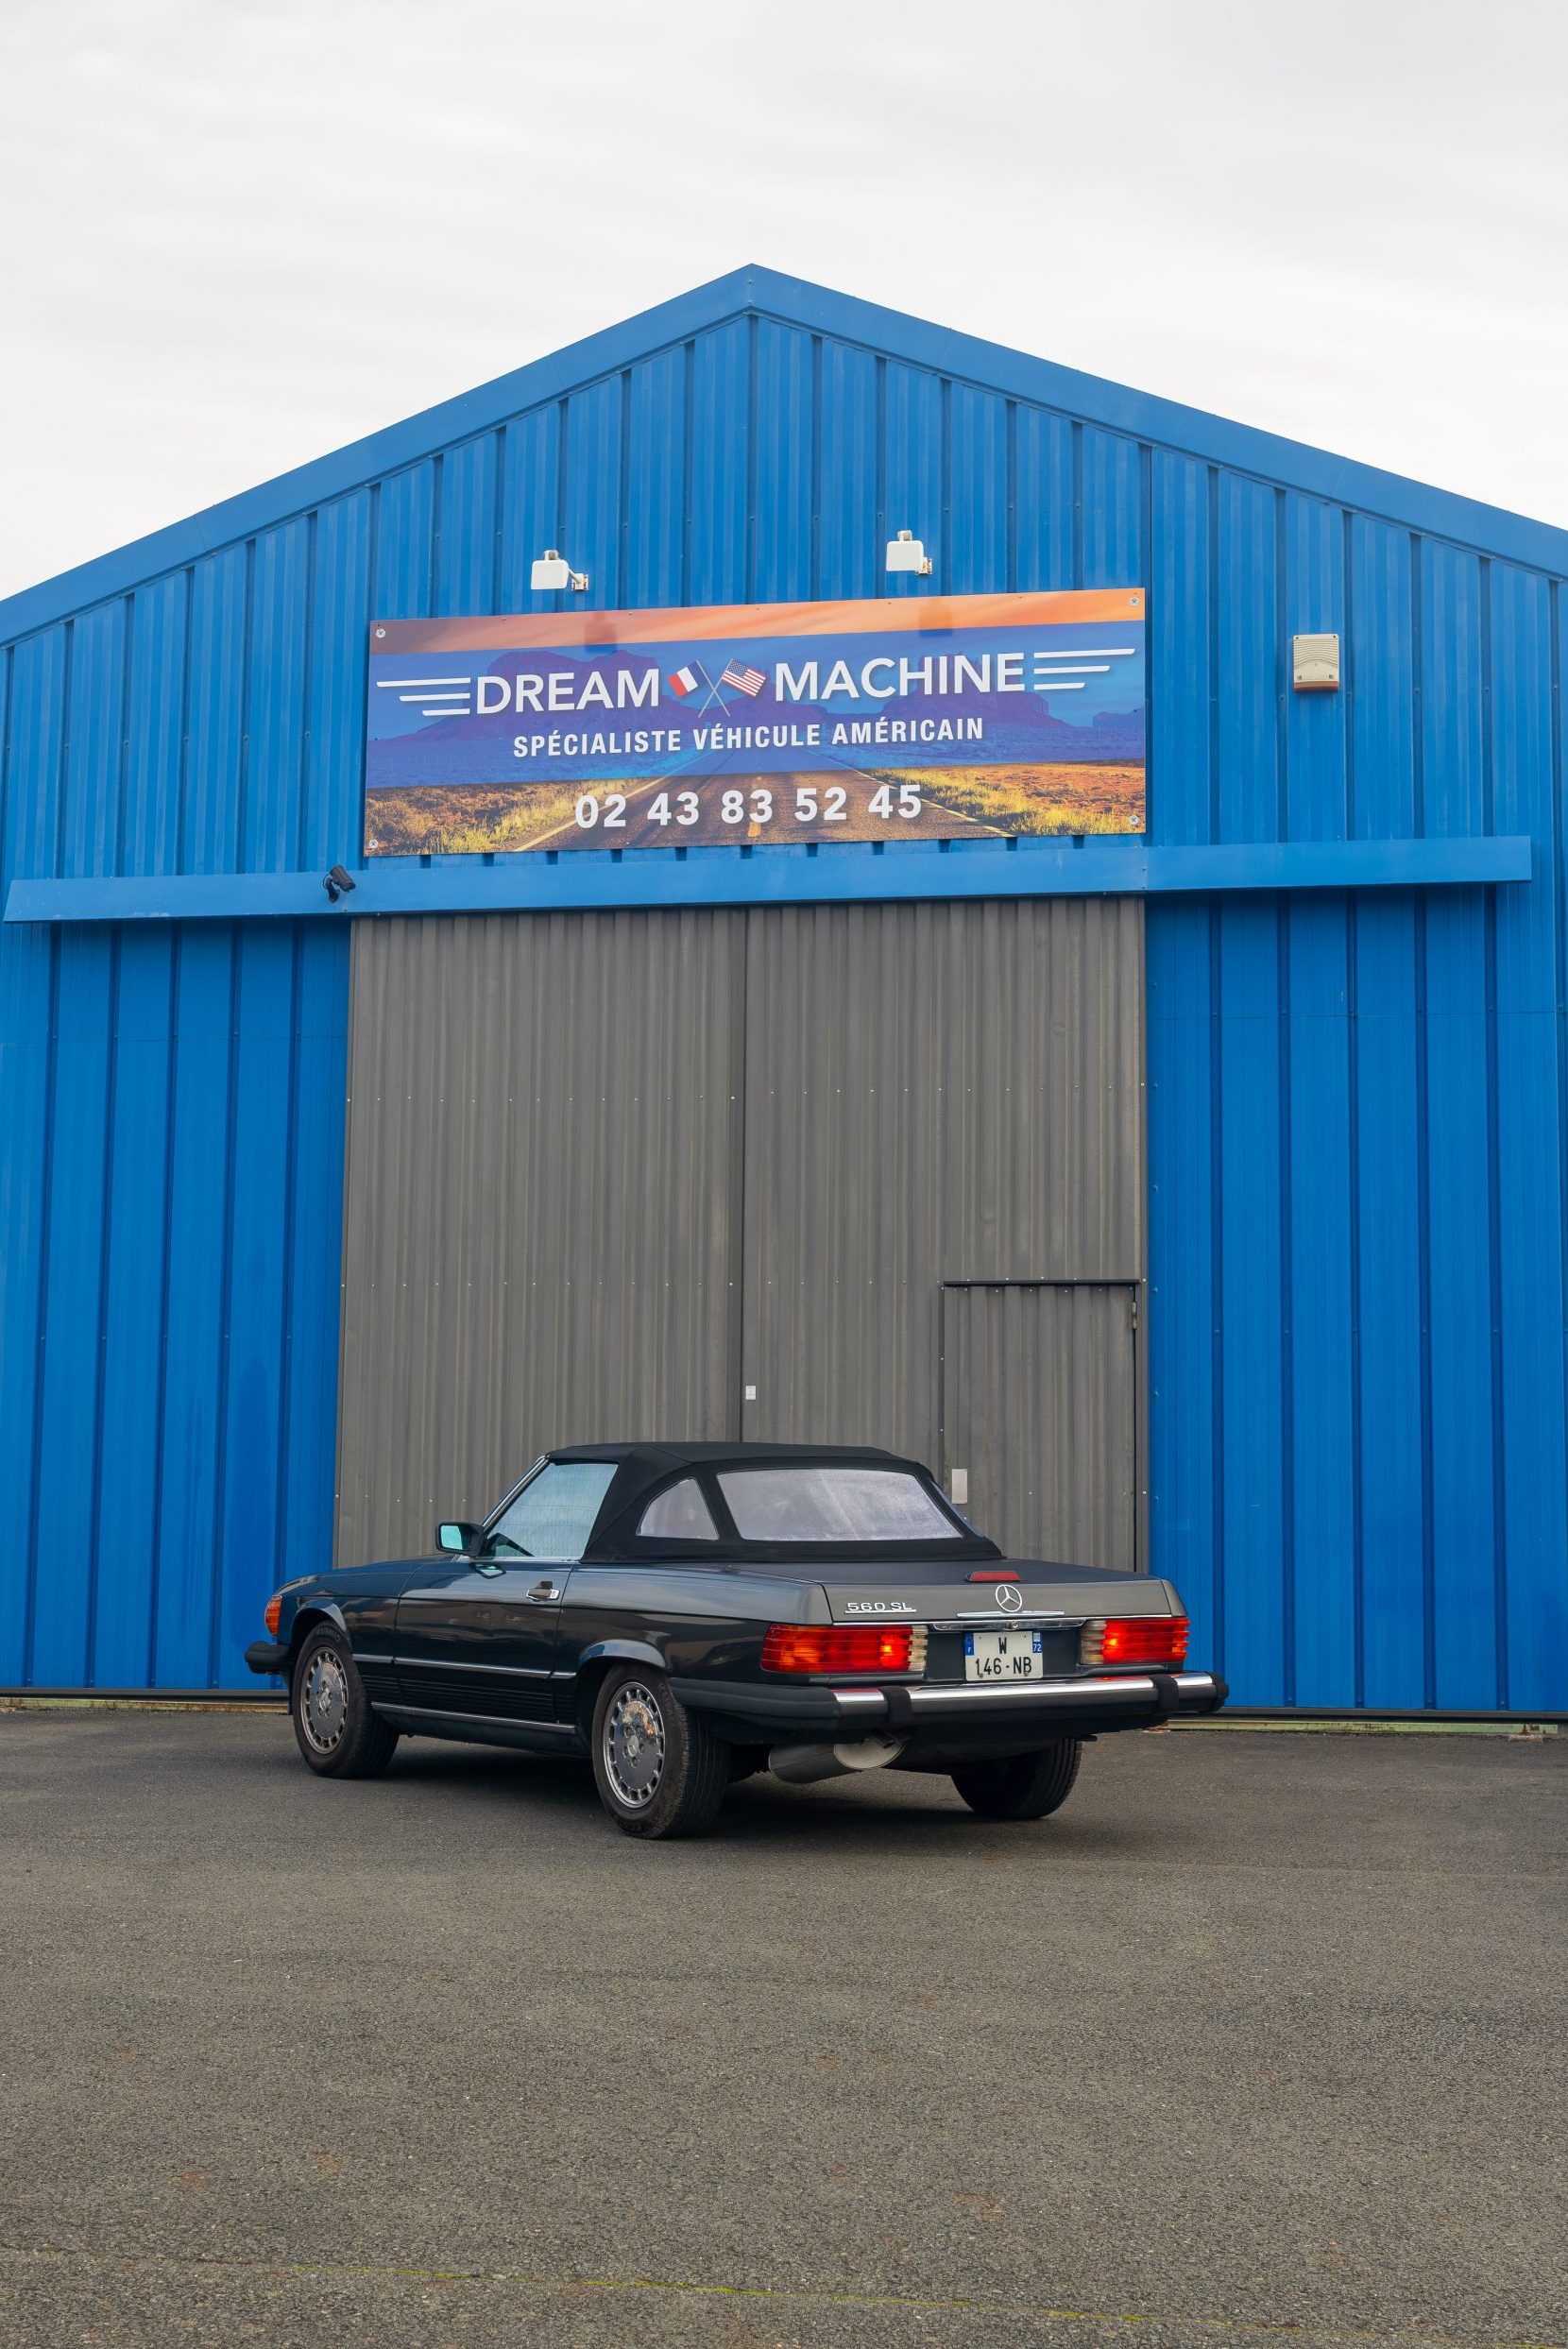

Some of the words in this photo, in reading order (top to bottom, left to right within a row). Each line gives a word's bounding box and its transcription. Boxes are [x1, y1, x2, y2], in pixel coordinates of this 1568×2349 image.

[477, 668, 659, 715] DREAM
[775, 652, 1025, 702] MACHINE
[513, 729, 682, 757] SPÉCIALISTE
[693, 723, 821, 751] VÉHICULE
[831, 716, 983, 745] AMÉRICAIN
[573, 794, 627, 828] 02
[647, 792, 700, 826] 43
[721, 789, 774, 825] 83
[793, 787, 848, 822] 52
[868, 784, 922, 820] 45
[847, 1602, 886, 1611] 560
[890, 1601, 912, 1610] SL
[997, 1637, 1008, 1655] W
[1032, 1643, 1042, 1653] 72
